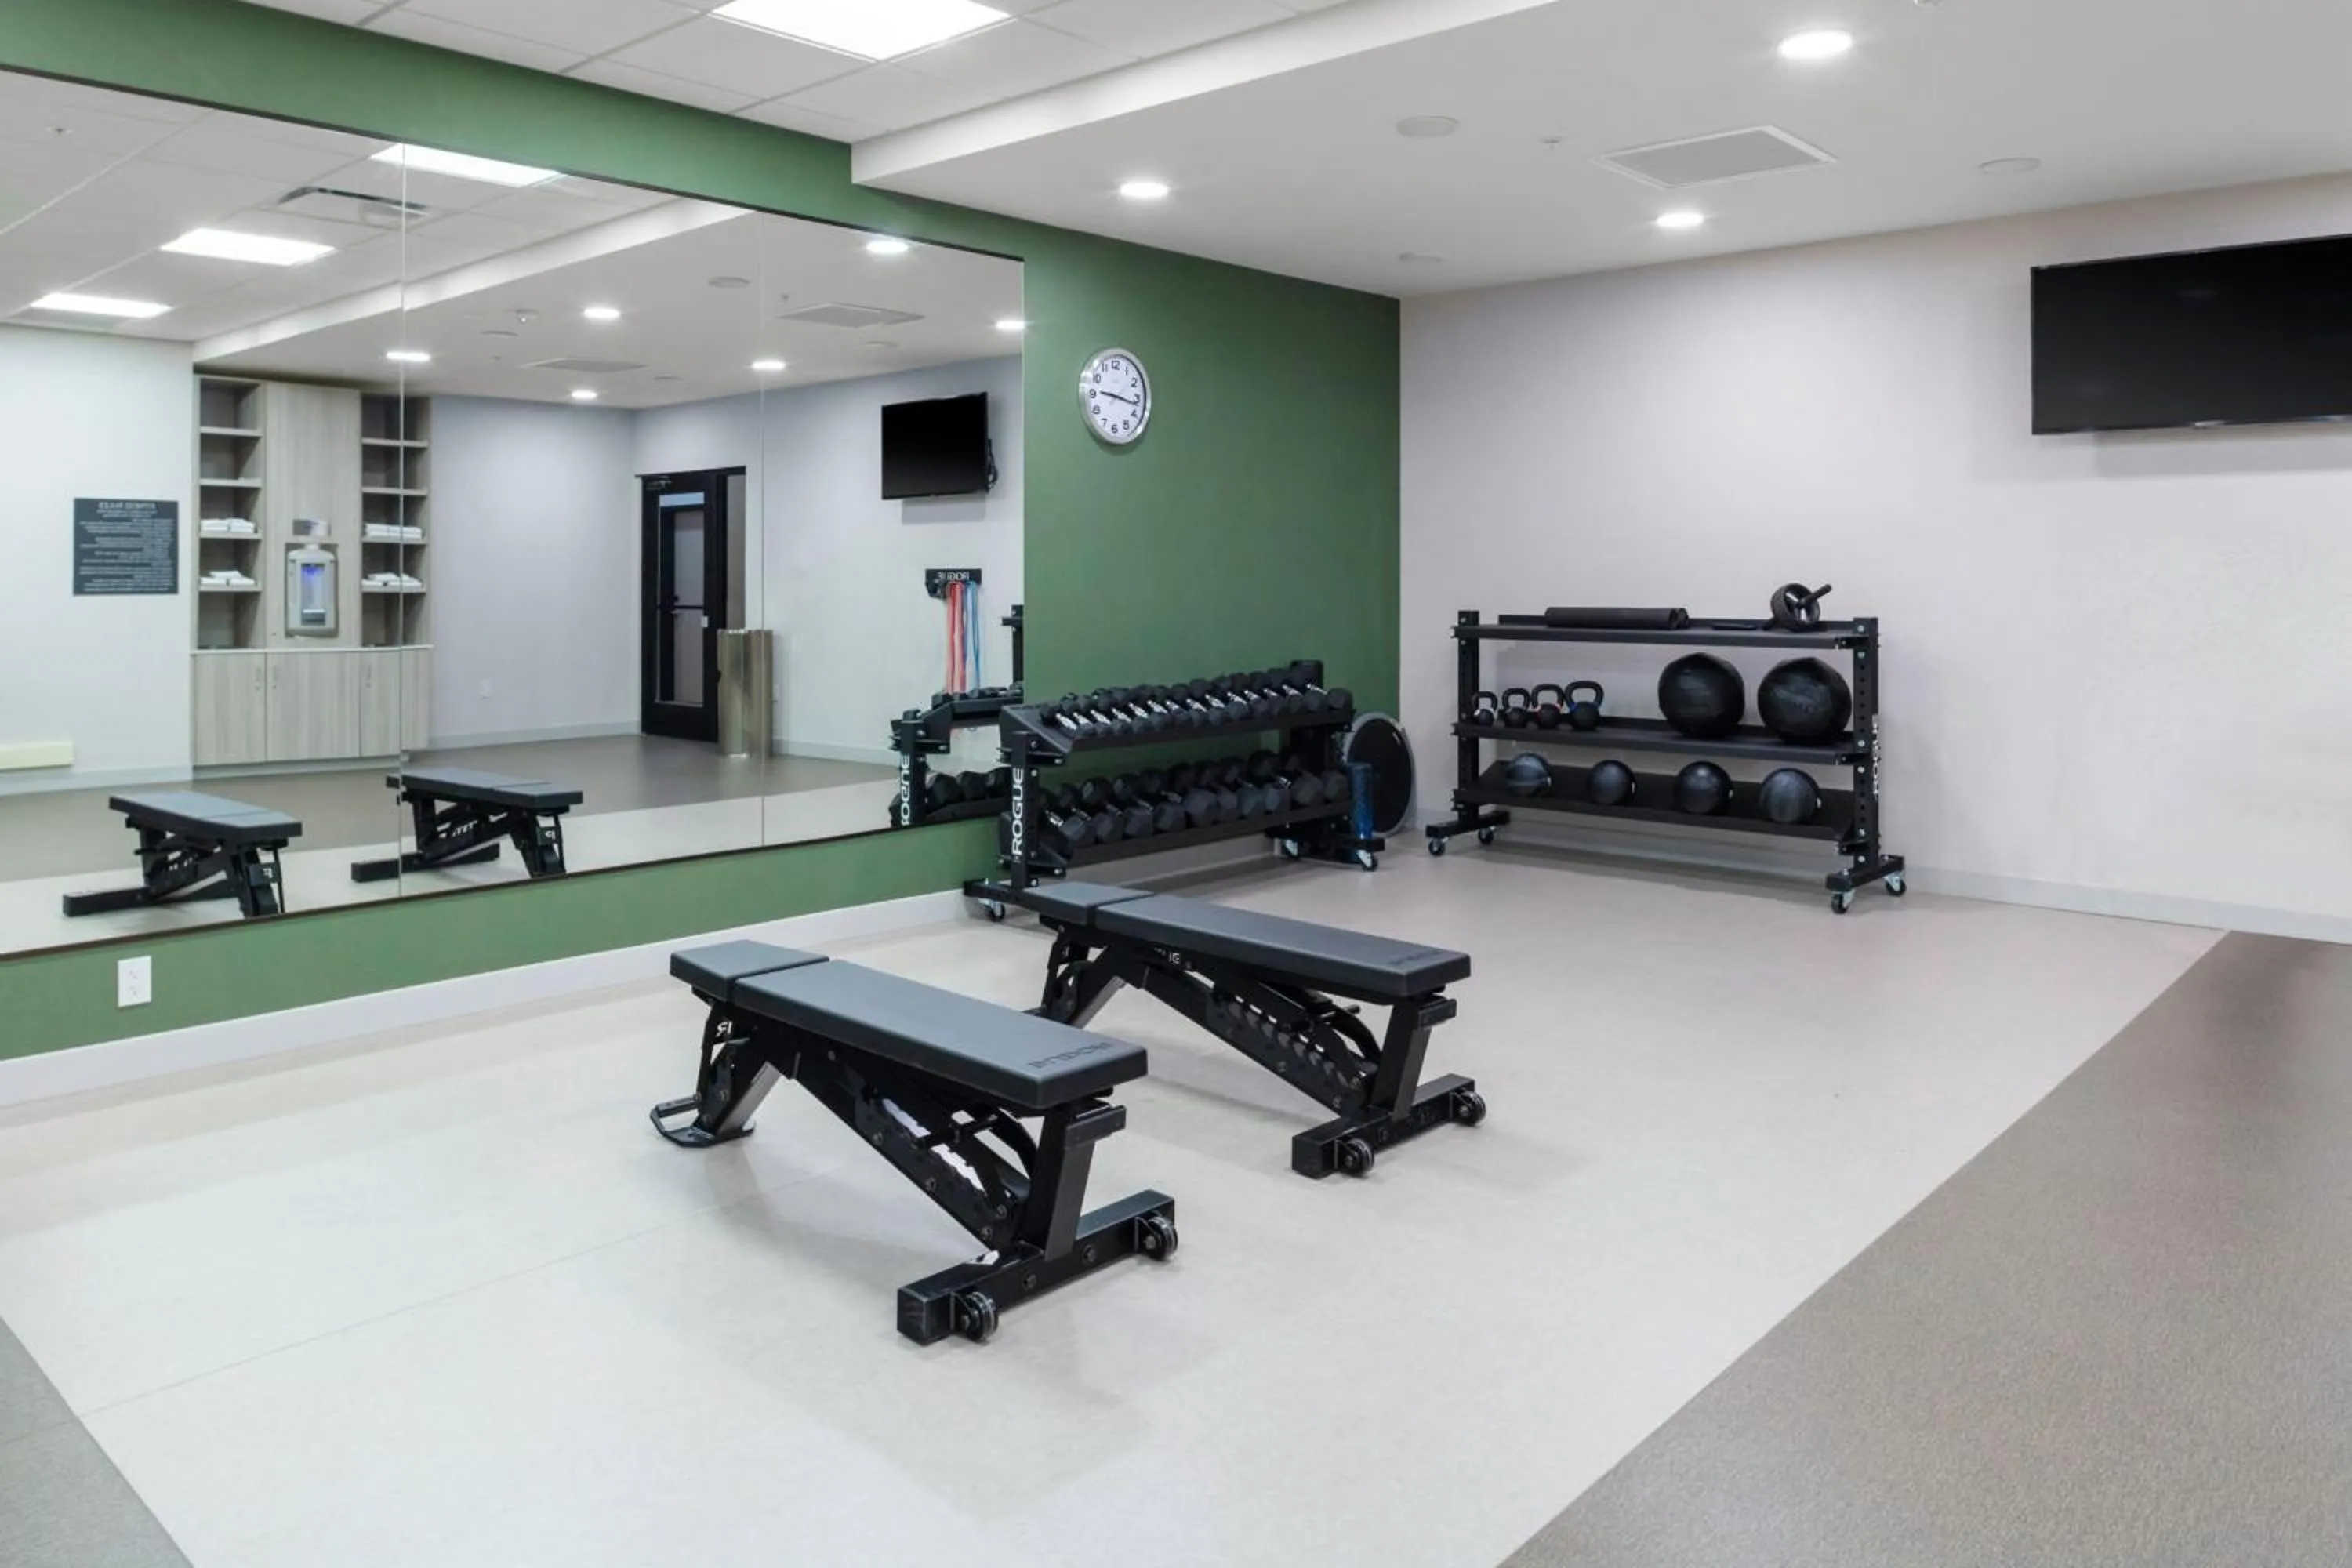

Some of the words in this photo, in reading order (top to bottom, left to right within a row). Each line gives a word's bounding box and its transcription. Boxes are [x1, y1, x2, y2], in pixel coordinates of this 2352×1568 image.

[1102, 362, 1108, 372] 11
[1111, 360, 1120, 370] 12
[1093, 373, 1102, 383] 10
[1131, 377, 1138, 387] 2
[1089, 389, 1097, 398] 9
[1133, 394, 1140, 405] 3
[1092, 405, 1101, 414] 8
[1131, 409, 1138, 418] 4
[1101, 418, 1107, 426] 7
[1123, 419, 1129, 430] 5
[1111, 424, 1118, 434] 6
[1012, 768, 1023, 855] ROGUE
